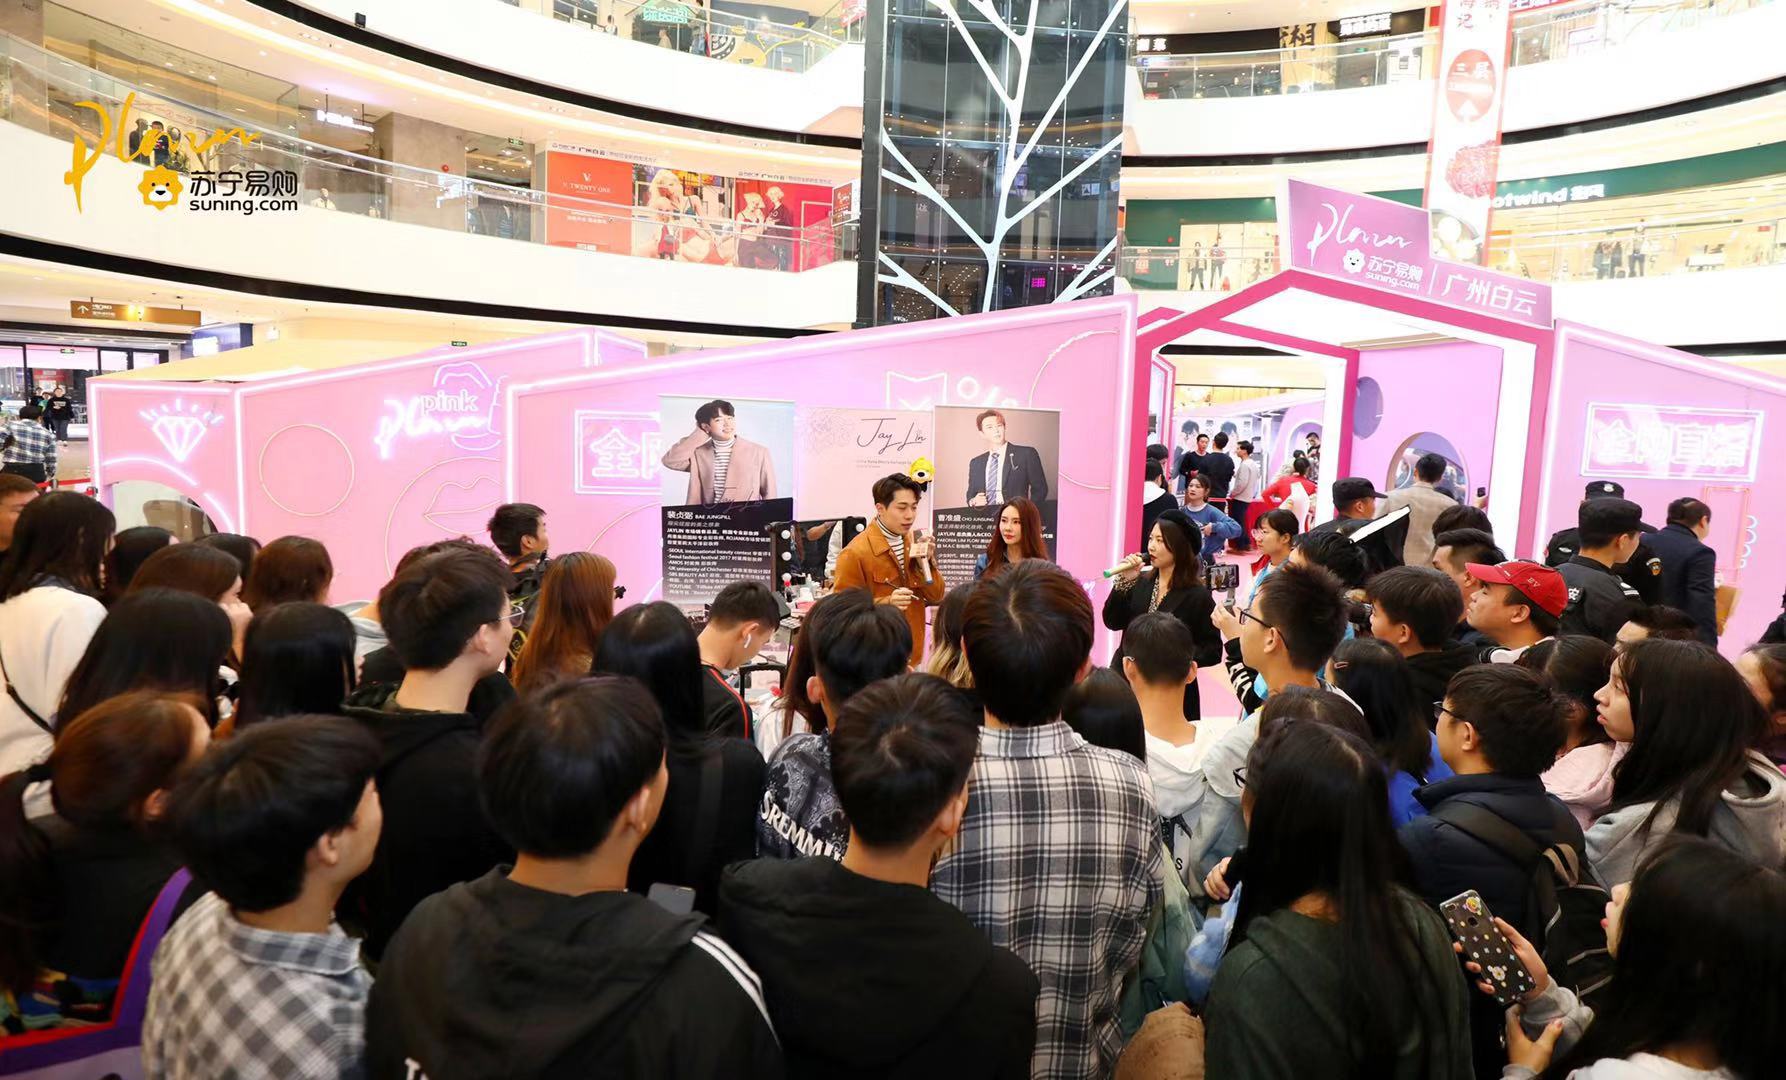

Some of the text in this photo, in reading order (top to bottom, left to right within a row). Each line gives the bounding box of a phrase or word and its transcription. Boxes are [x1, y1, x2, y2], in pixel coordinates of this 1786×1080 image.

[1365, 271, 1420, 291] suning.com
[1367, 255, 1424, 282] 苏宁易购
[1441, 273, 1537, 316] 广州白云
[421, 388, 479, 416] pink
[857, 417, 927, 455] Jay Lin
